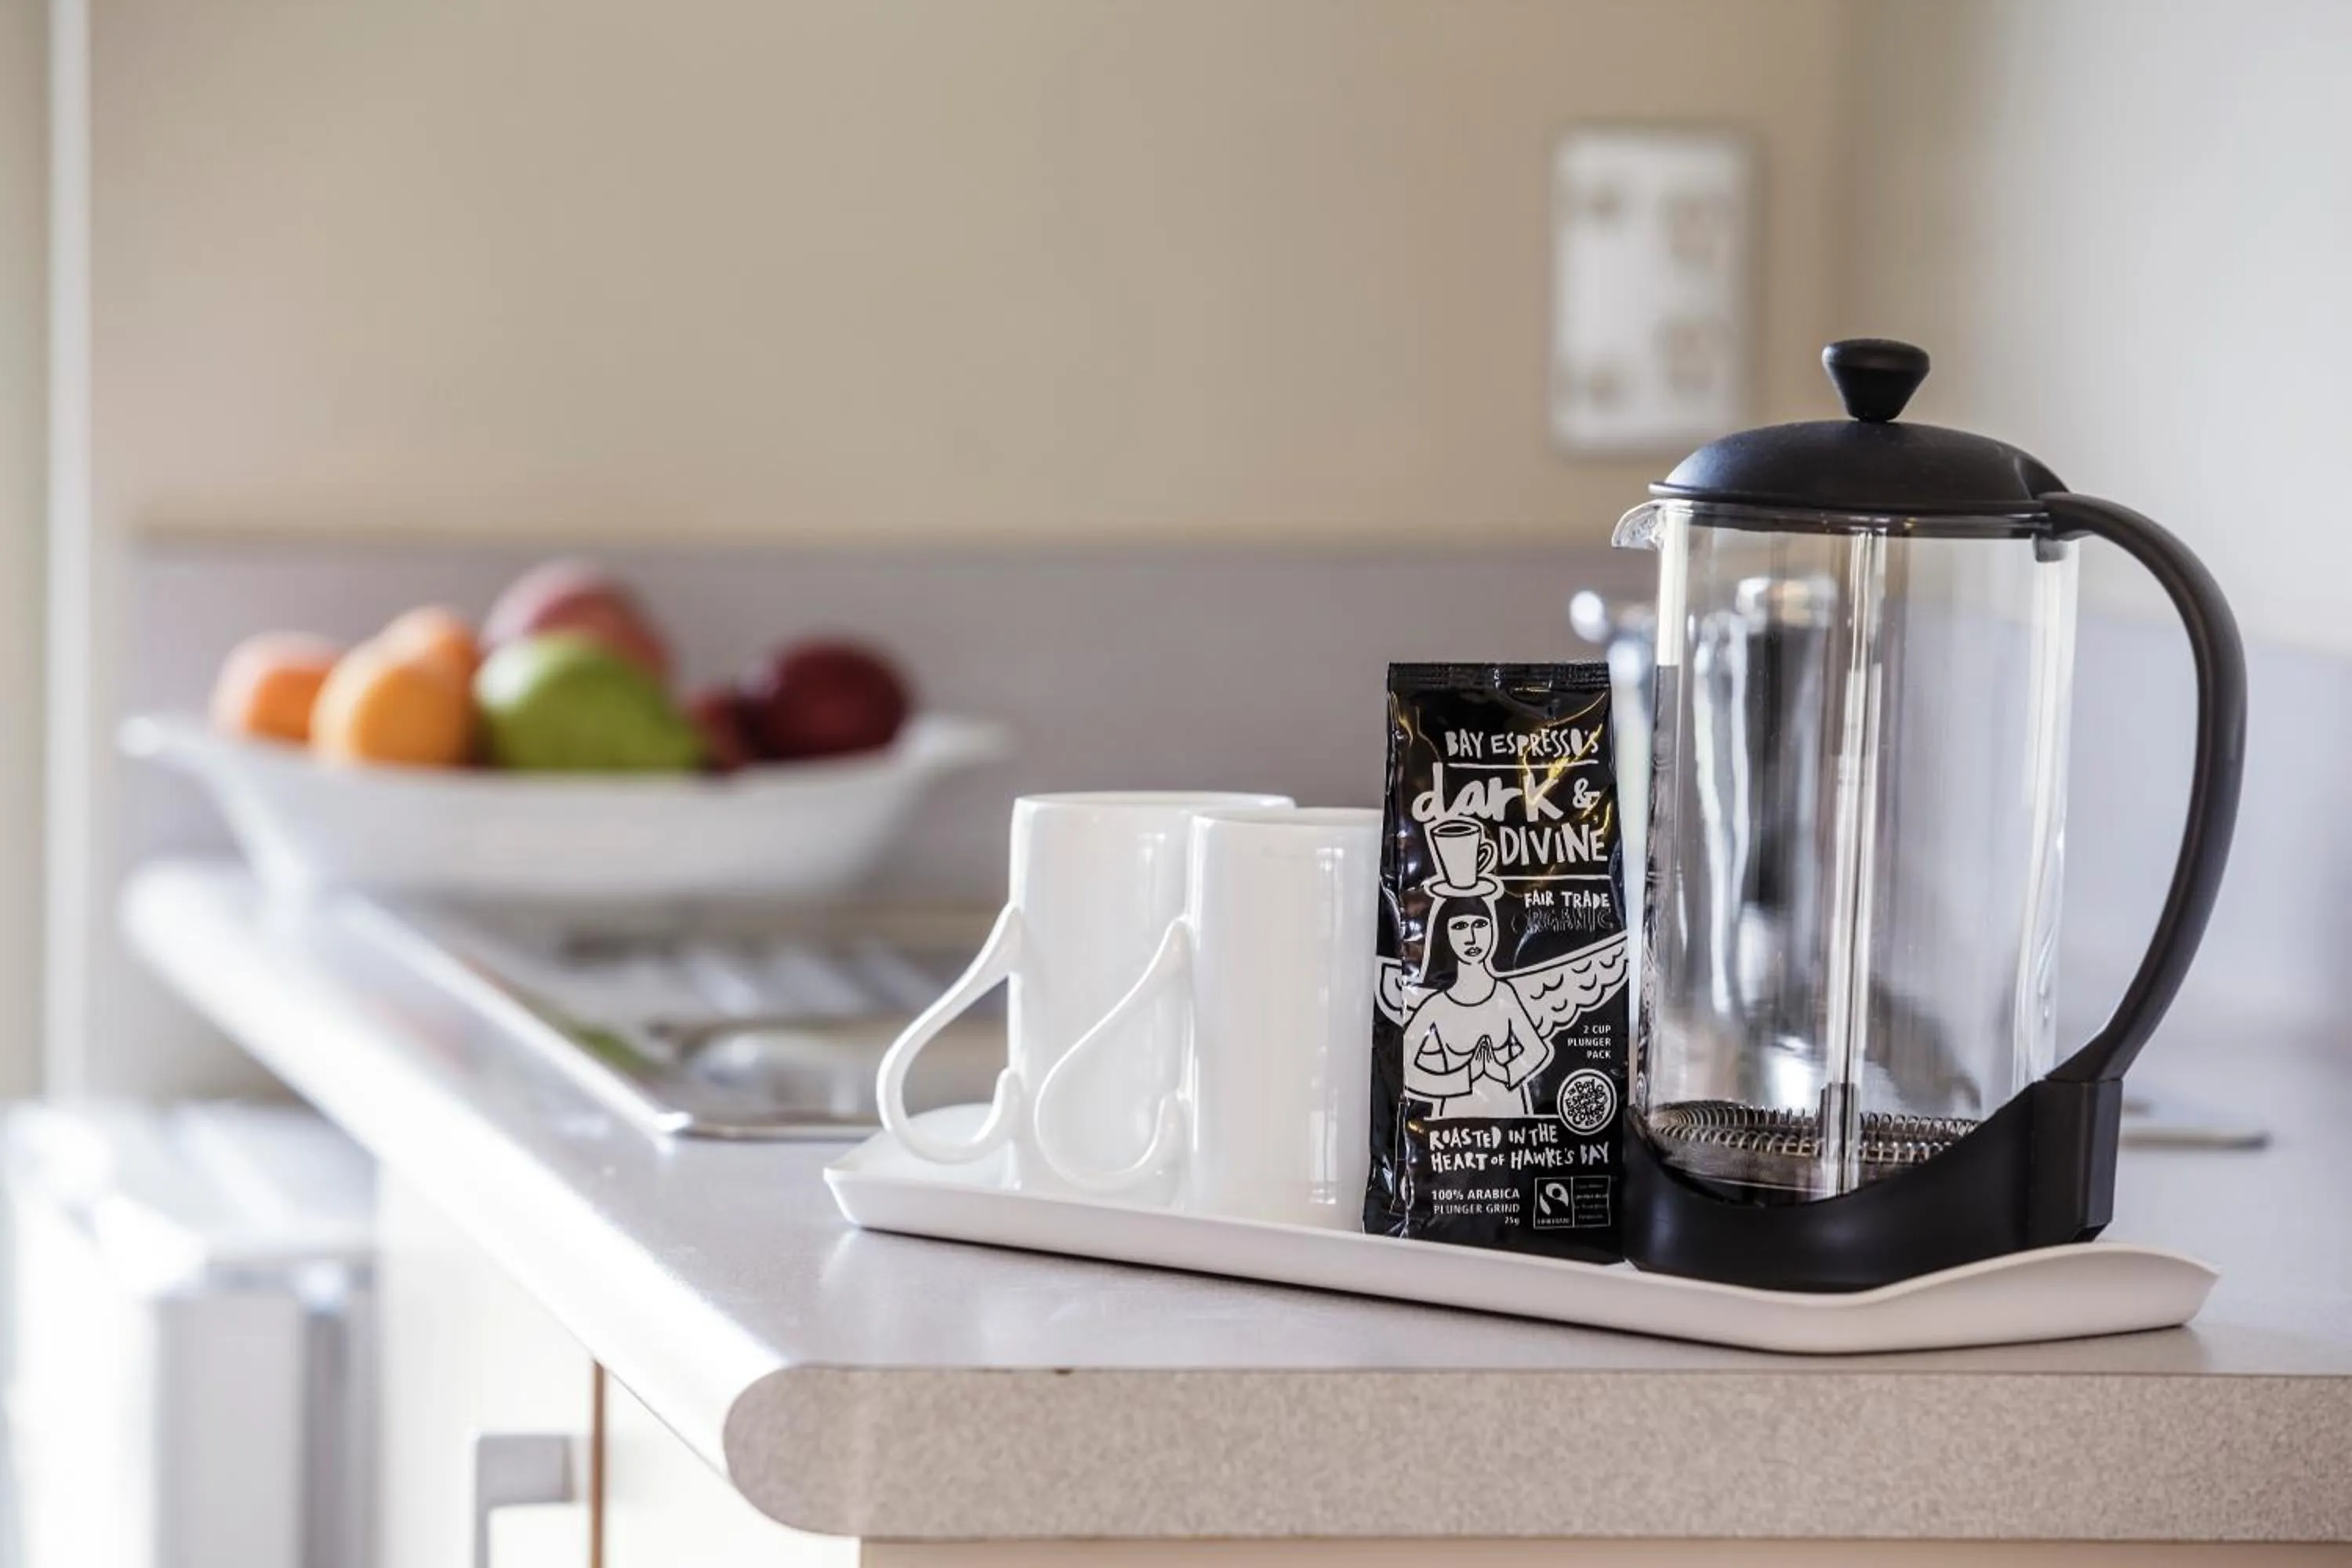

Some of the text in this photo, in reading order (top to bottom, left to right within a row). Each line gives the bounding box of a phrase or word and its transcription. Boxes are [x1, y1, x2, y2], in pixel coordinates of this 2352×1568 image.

[1444, 728, 1599, 758] BAY ESPRESSO'S
[1411, 762, 1600, 822] dark &
[1499, 822, 1608, 866] DIVINE
[1524, 889, 1610, 909] FAIR TRADE
[1583, 1025, 1611, 1034] 2 CUP
[1568, 1037, 1611, 1047] PLUNGER
[1587, 1050, 1611, 1059] PACK
[1429, 1122, 1559, 1151] ROASTED IN THE
[1430, 1152, 1488, 1173] HEART
[1511, 1147, 1575, 1170] HAWKE'S
[1432, 1189, 1520, 1200] 100% ARABICA
[1433, 1203, 1520, 1214] PLUNGER GRIND
